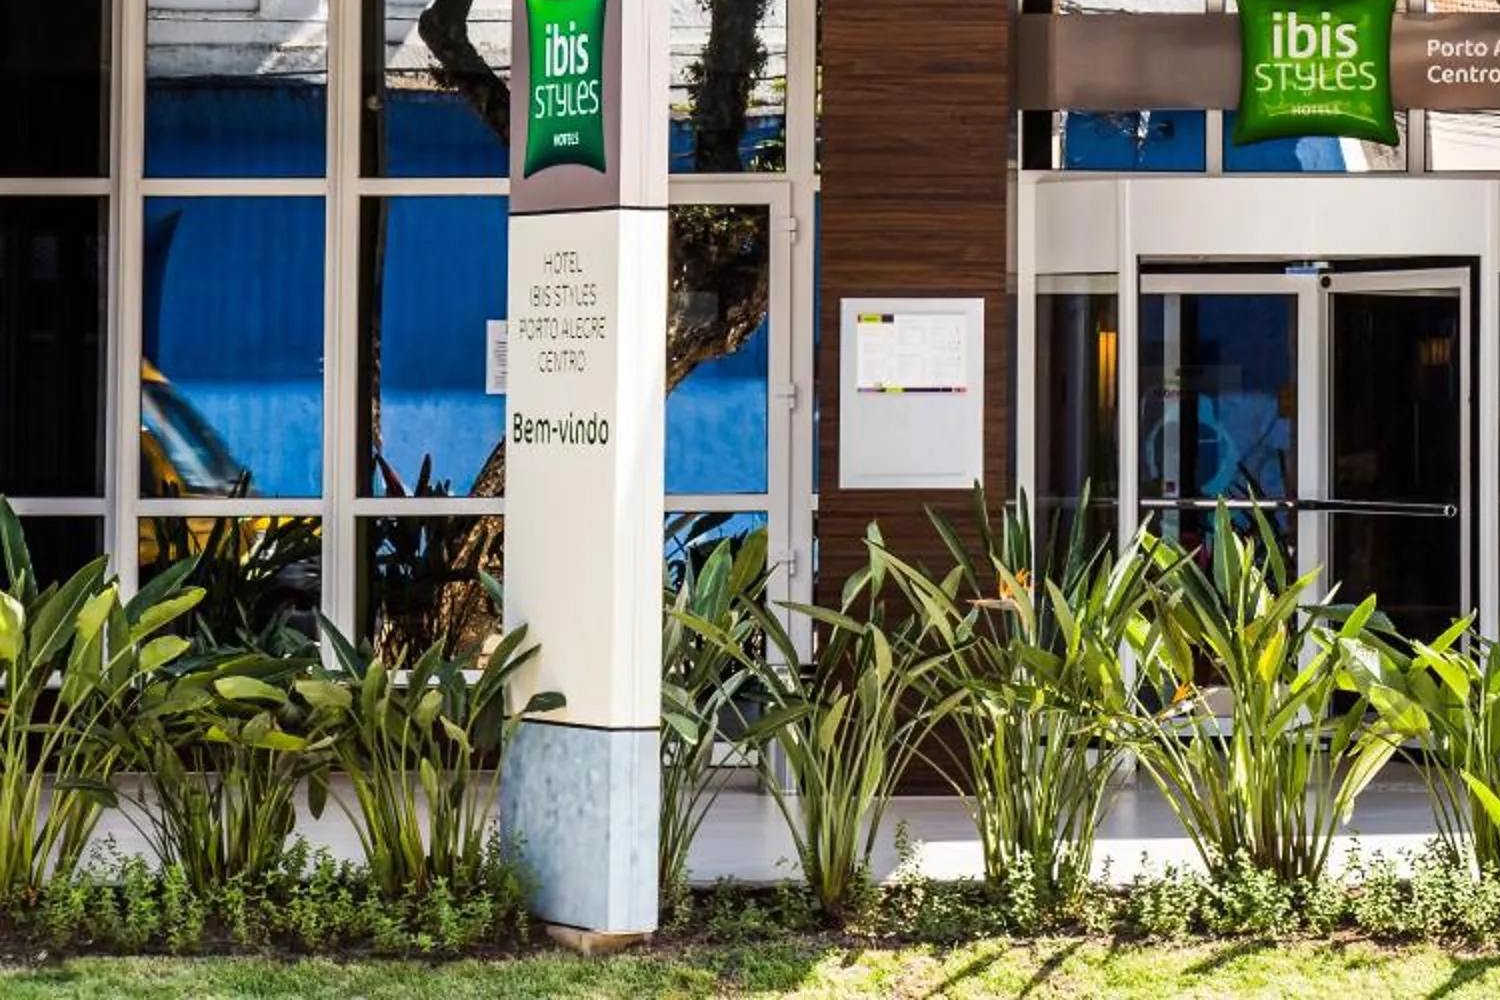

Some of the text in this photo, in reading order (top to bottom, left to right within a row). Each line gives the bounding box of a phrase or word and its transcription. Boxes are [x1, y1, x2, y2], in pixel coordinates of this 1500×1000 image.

[1272, 11, 1359, 59] ibis
[545, 20, 589, 77] ibis
[1426, 39, 1488, 57] Porto
[543, 250, 582, 274] HOTEL
[529, 283, 597, 307] IBIS STYLES
[519, 317, 605, 340] PORTO ALEGRE
[539, 350, 586, 373] CENTRO
[513, 411, 609, 445] Bem-vindo
